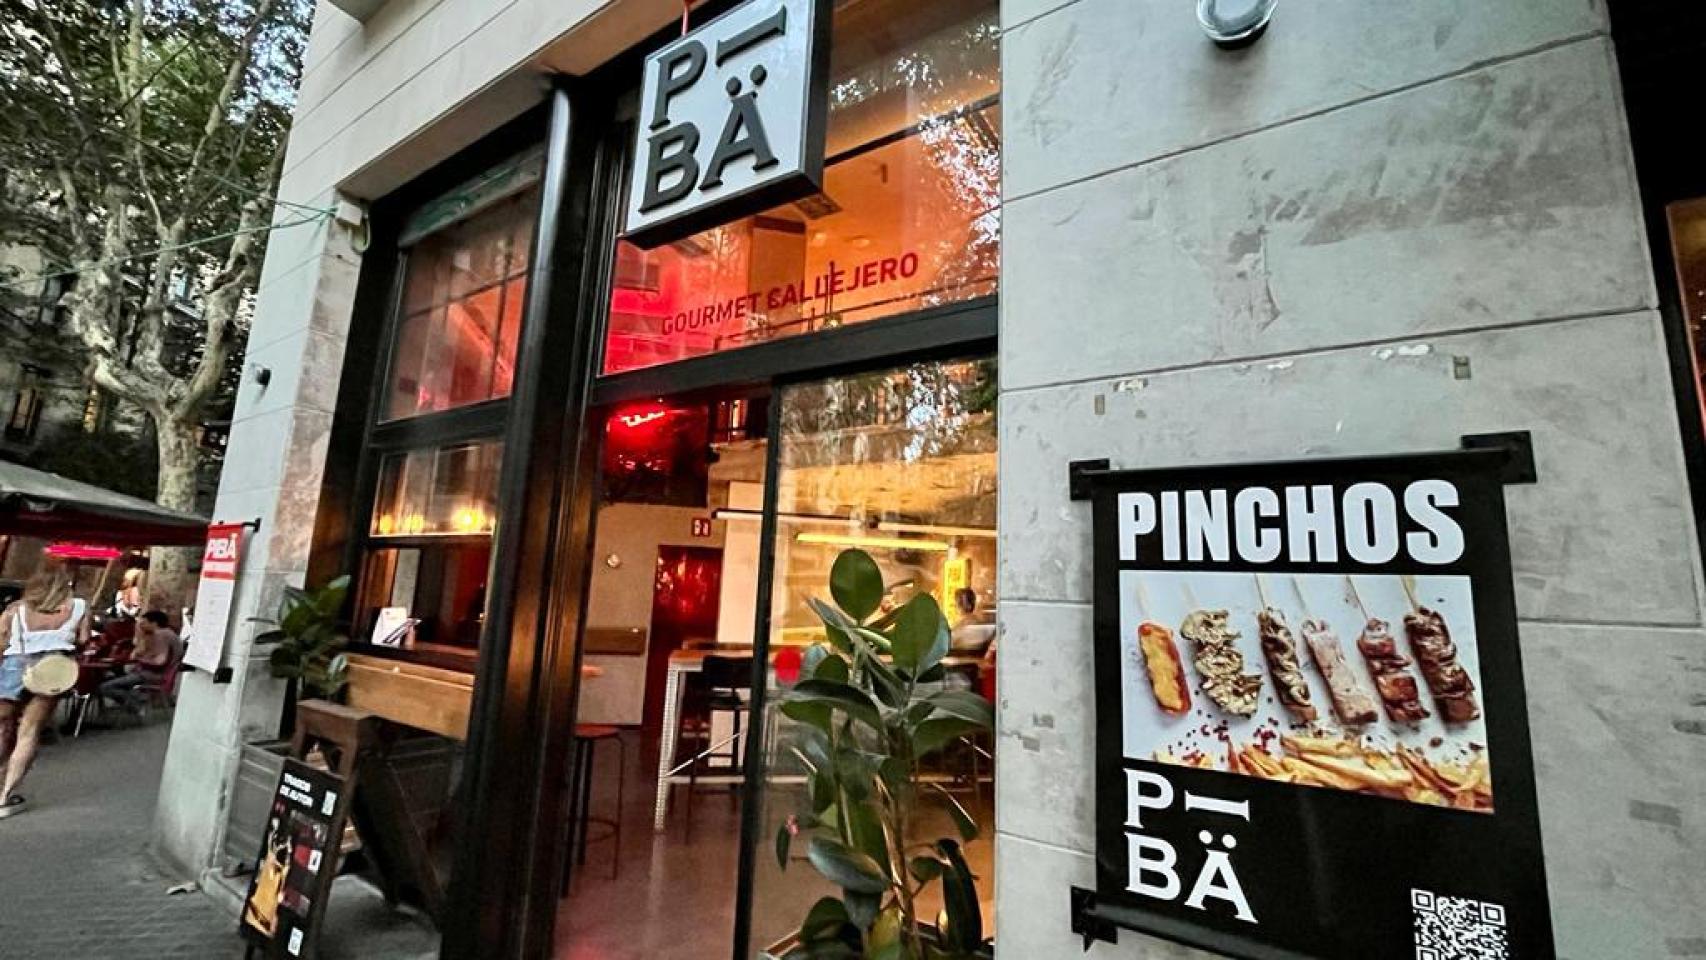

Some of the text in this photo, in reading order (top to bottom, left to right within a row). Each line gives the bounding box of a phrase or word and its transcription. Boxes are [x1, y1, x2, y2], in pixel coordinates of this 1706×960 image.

[638, 64, 780, 215] BÄ
[661, 252, 919, 336] GOURMET CALLEJERO
[1117, 479, 1466, 565] PINCHOS
[1123, 829, 1259, 924] BÄ
